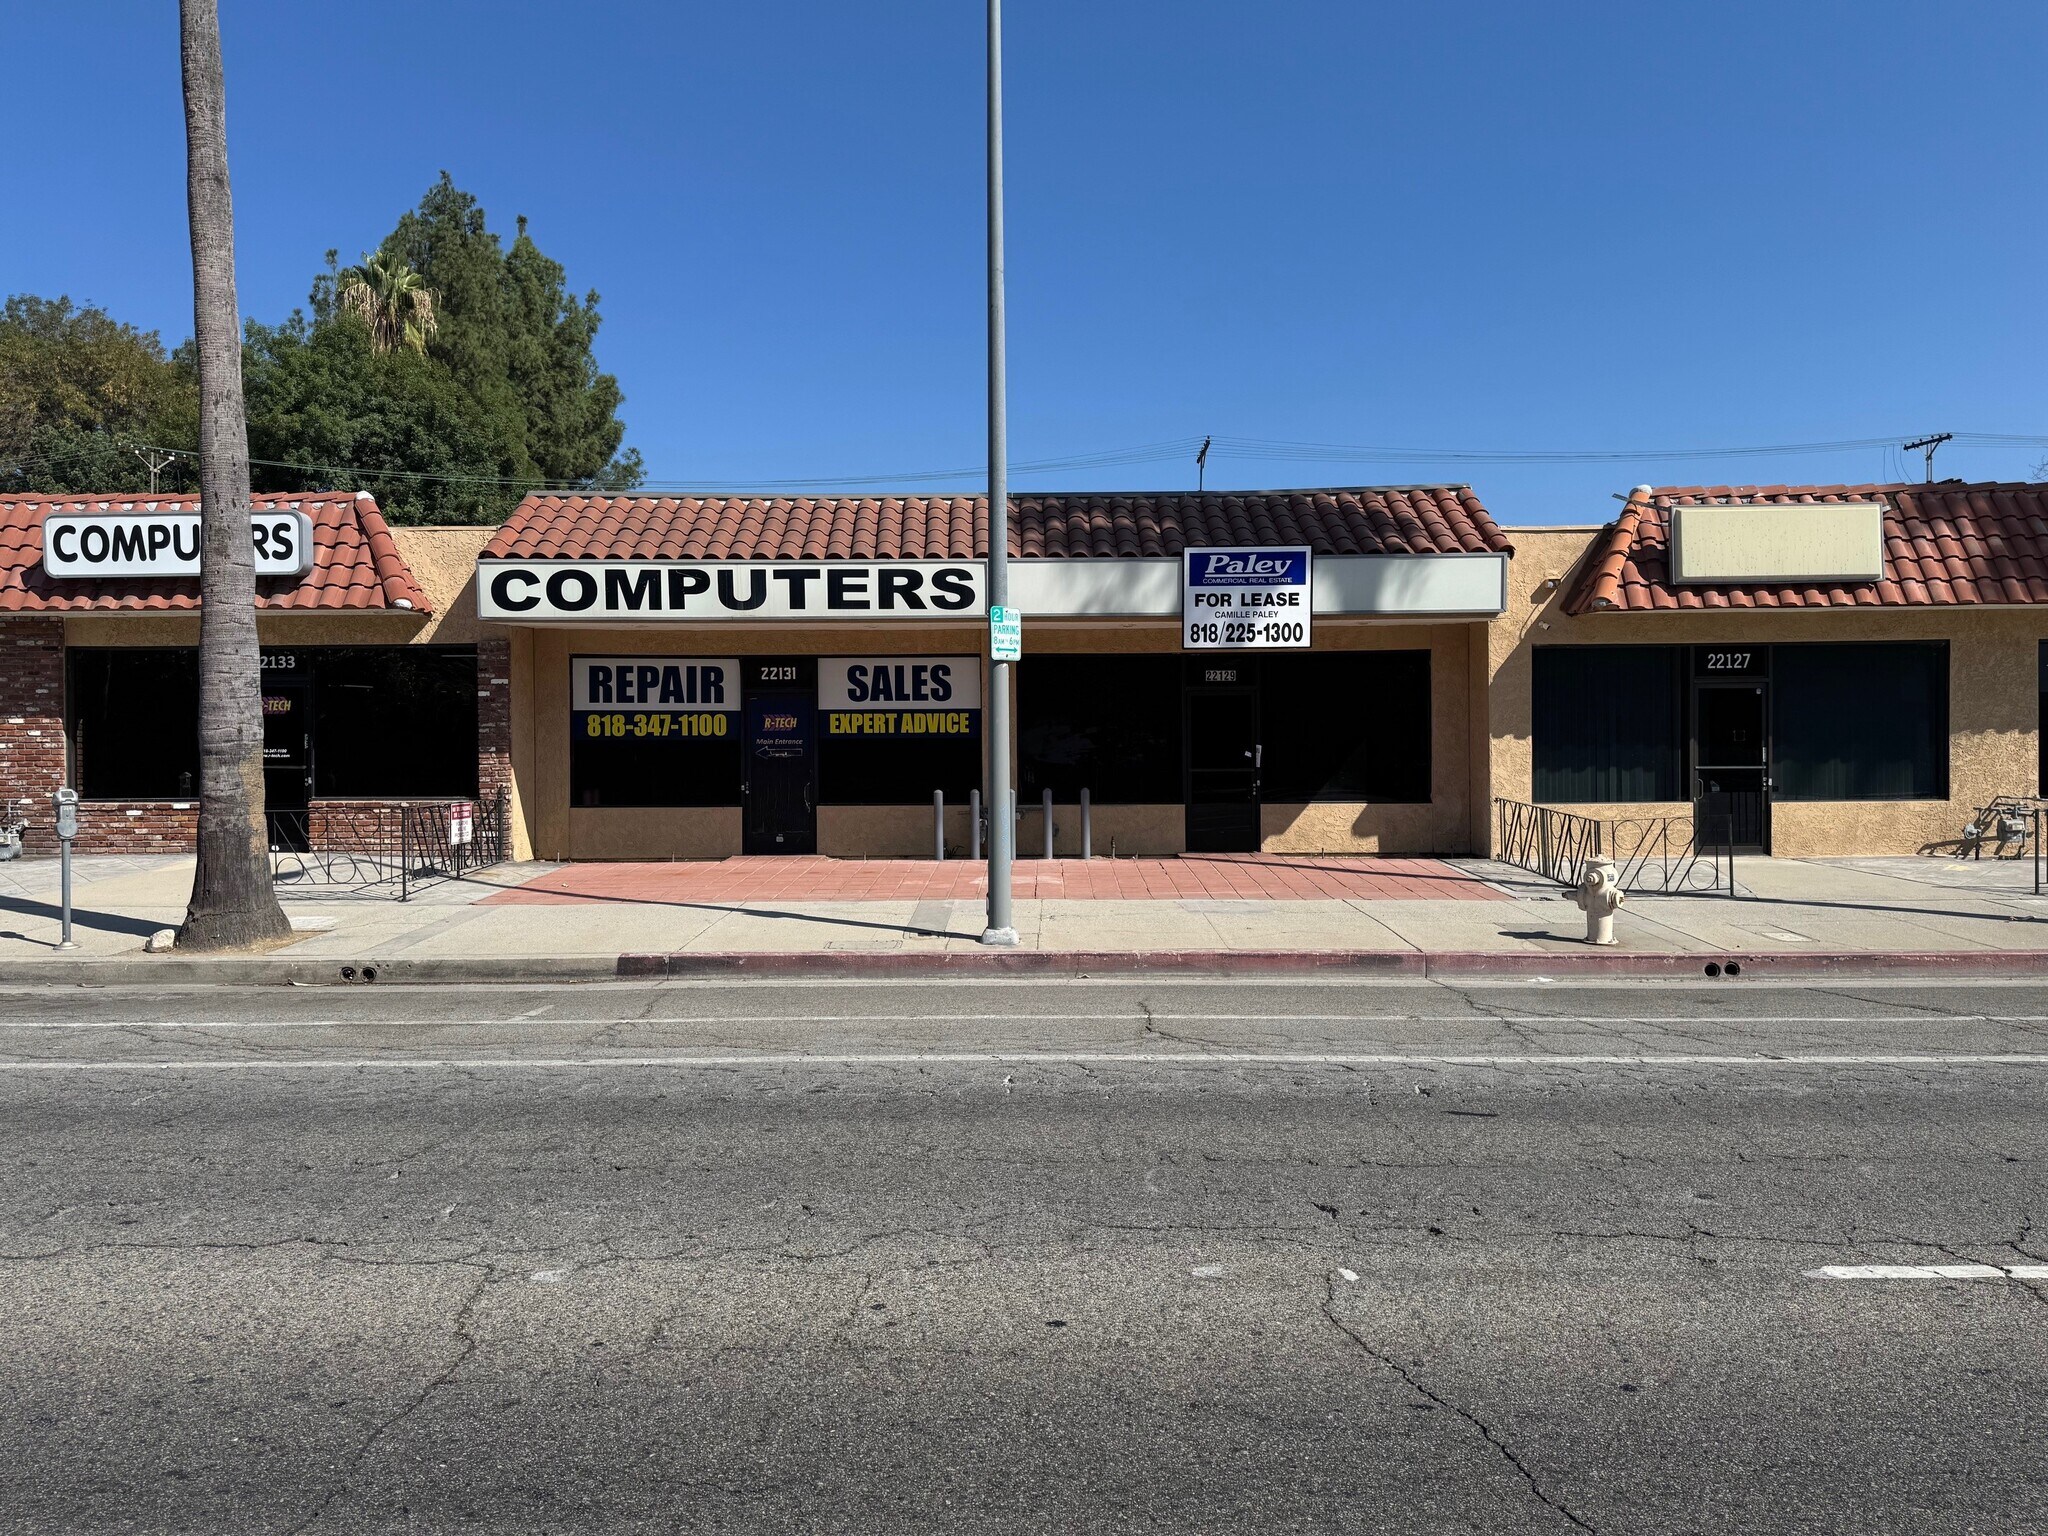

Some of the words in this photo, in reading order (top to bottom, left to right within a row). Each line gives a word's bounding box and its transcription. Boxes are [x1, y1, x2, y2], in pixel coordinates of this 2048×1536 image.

[52, 522, 294, 563] COMPURS
[1204, 554, 1293, 577] Paley
[490, 567, 976, 612] COMPUTERS
[1194, 593, 1232, 607] FOR
[1240, 592, 1300, 607] LEASE
[993, 608, 1001, 621] 2
[1004, 613, 1019, 621] HOUR
[1252, 610, 1279, 618] PALEY
[993, 624, 1020, 636] PARKING
[1190, 621, 1303, 644] 818/225-1300
[260, 655, 296, 669] 2133
[1707, 653, 1751, 669] 22127
[761, 667, 796, 680] 22131
[1206, 670, 1236, 681] 22129
[588, 665, 725, 704] REPAIR
[847, 664, 952, 702] SALES
[262, 700, 292, 711] -TECH
[587, 713, 727, 737] 818-347-1100
[764, 717, 798, 729] R-TECH
[829, 712, 897, 734] EXPERT
[900, 712, 970, 734] ADVICE
